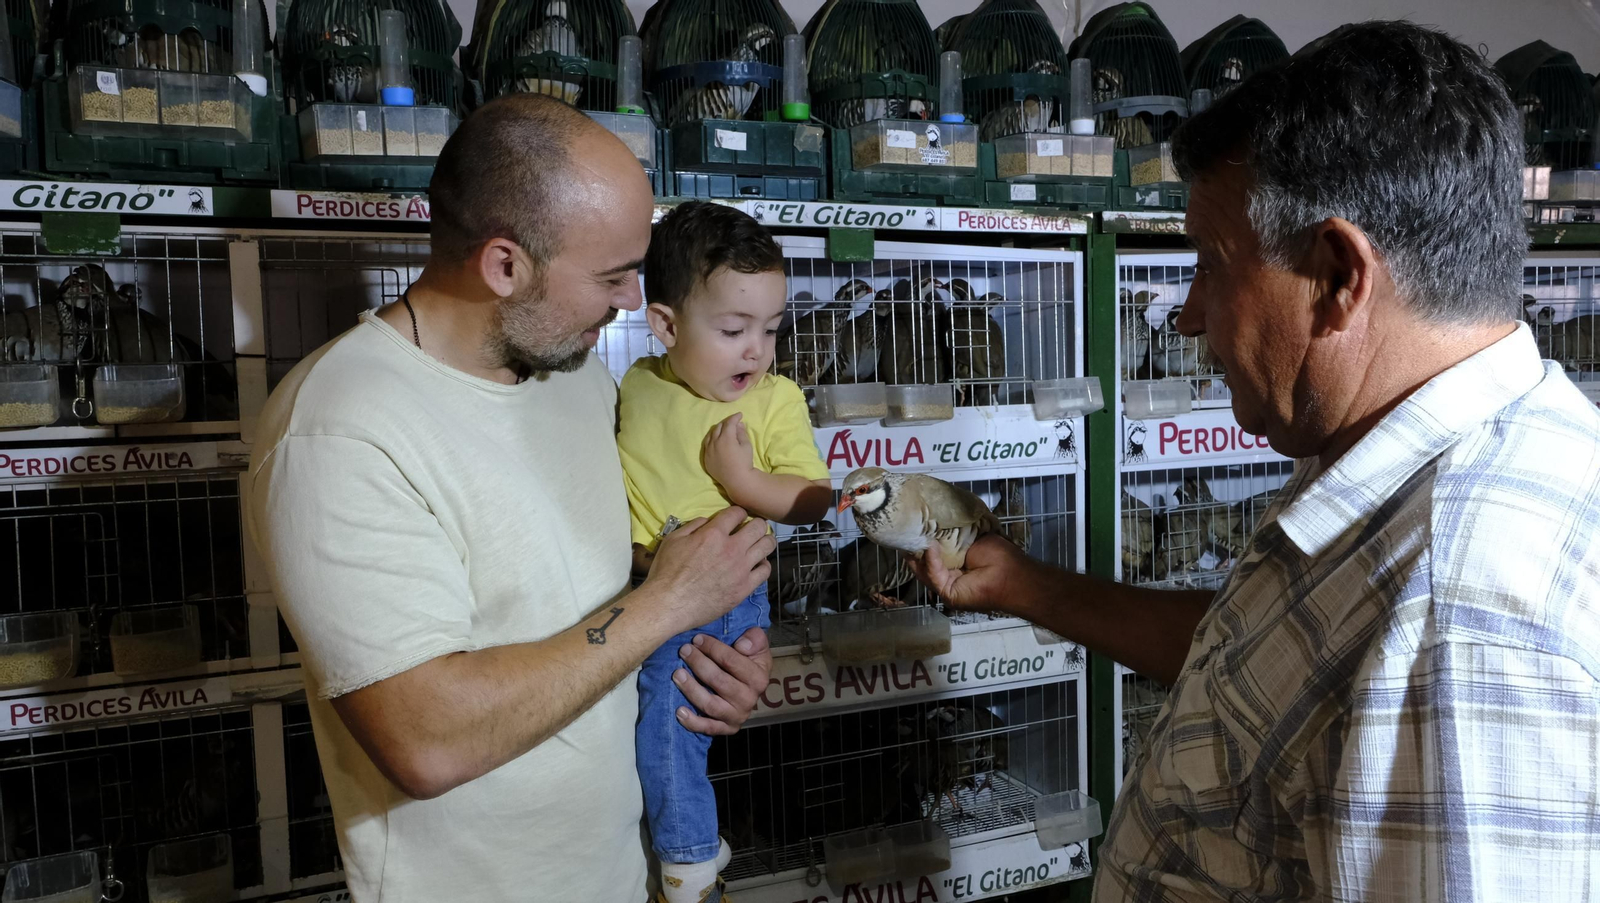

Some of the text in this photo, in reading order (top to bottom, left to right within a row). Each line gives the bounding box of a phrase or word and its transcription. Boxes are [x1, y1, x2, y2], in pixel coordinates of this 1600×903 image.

[296, 194, 401, 219] PERDICES
[768, 204, 916, 228] "El Gitano"
[958, 210, 1028, 230] PERDICES
[0, 446, 193, 477] PERDICES ÁVILA
[827, 429, 1048, 469] ÁVILA "El Gitano"
[937, 661, 968, 684] "El
[974, 650, 1054, 680] Gitano"
[10, 687, 208, 726] PERDICES ÁVILA
[943, 876, 974, 899] "El
[979, 857, 1059, 891] Gitano"
